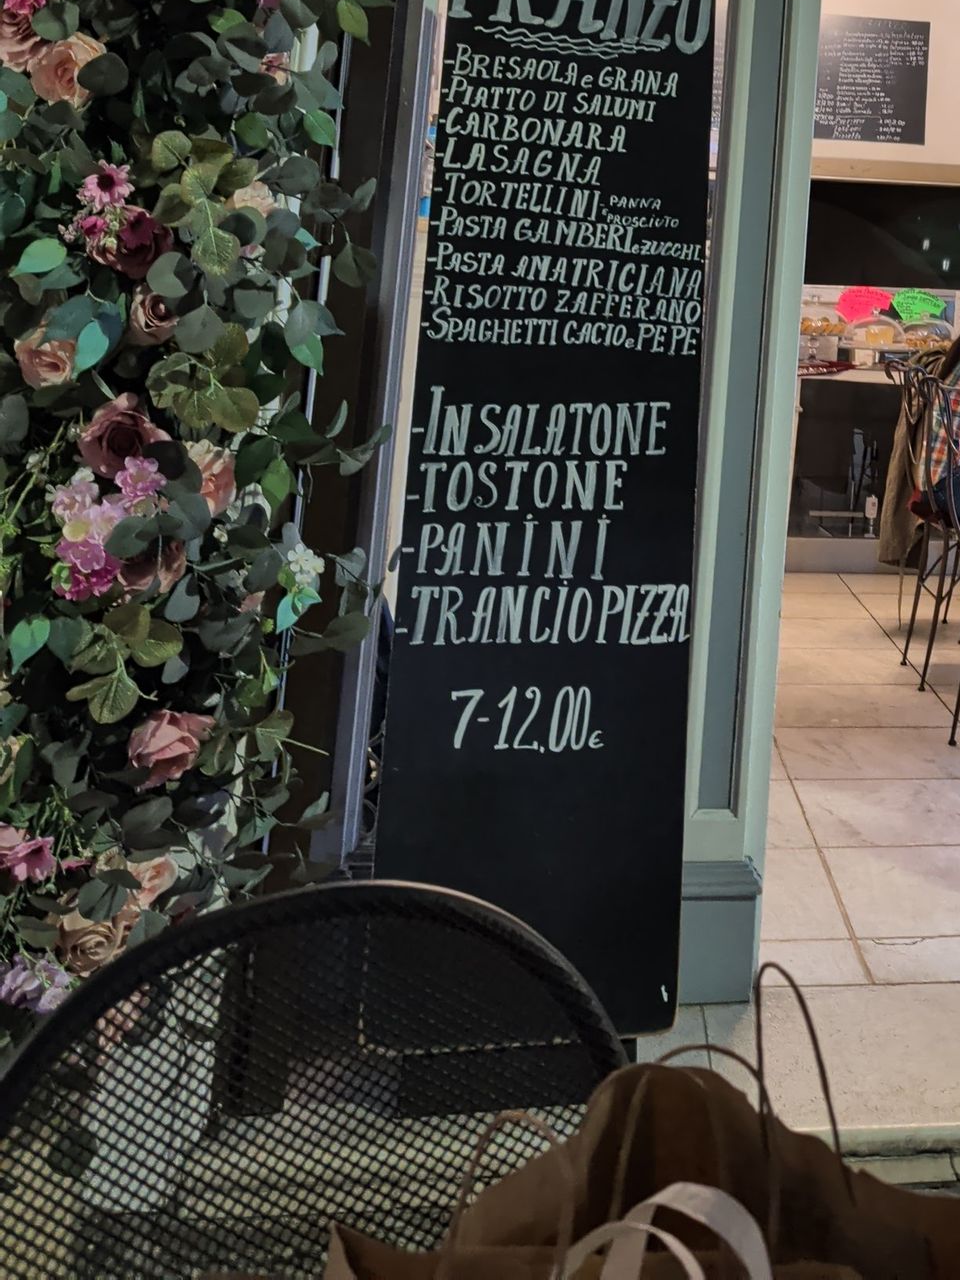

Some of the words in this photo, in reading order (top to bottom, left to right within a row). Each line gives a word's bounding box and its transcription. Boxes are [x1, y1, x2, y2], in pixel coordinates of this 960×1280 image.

[598, 66, 679, 98] GRANA
[543, 90, 565, 114] DI
[572, 92, 657, 122] SALUMI
[609, 194, 662, 211] PANNA
[513, 216, 634, 254] GAMBERI
[511, 254, 703, 302] AMATRICIANA
[554, 289, 701, 324] ZAFFERANO
[562, 321, 628, 347] CACIO
[633, 323, 700, 356] PEPE
[595, 584, 691, 645] PIZZA
